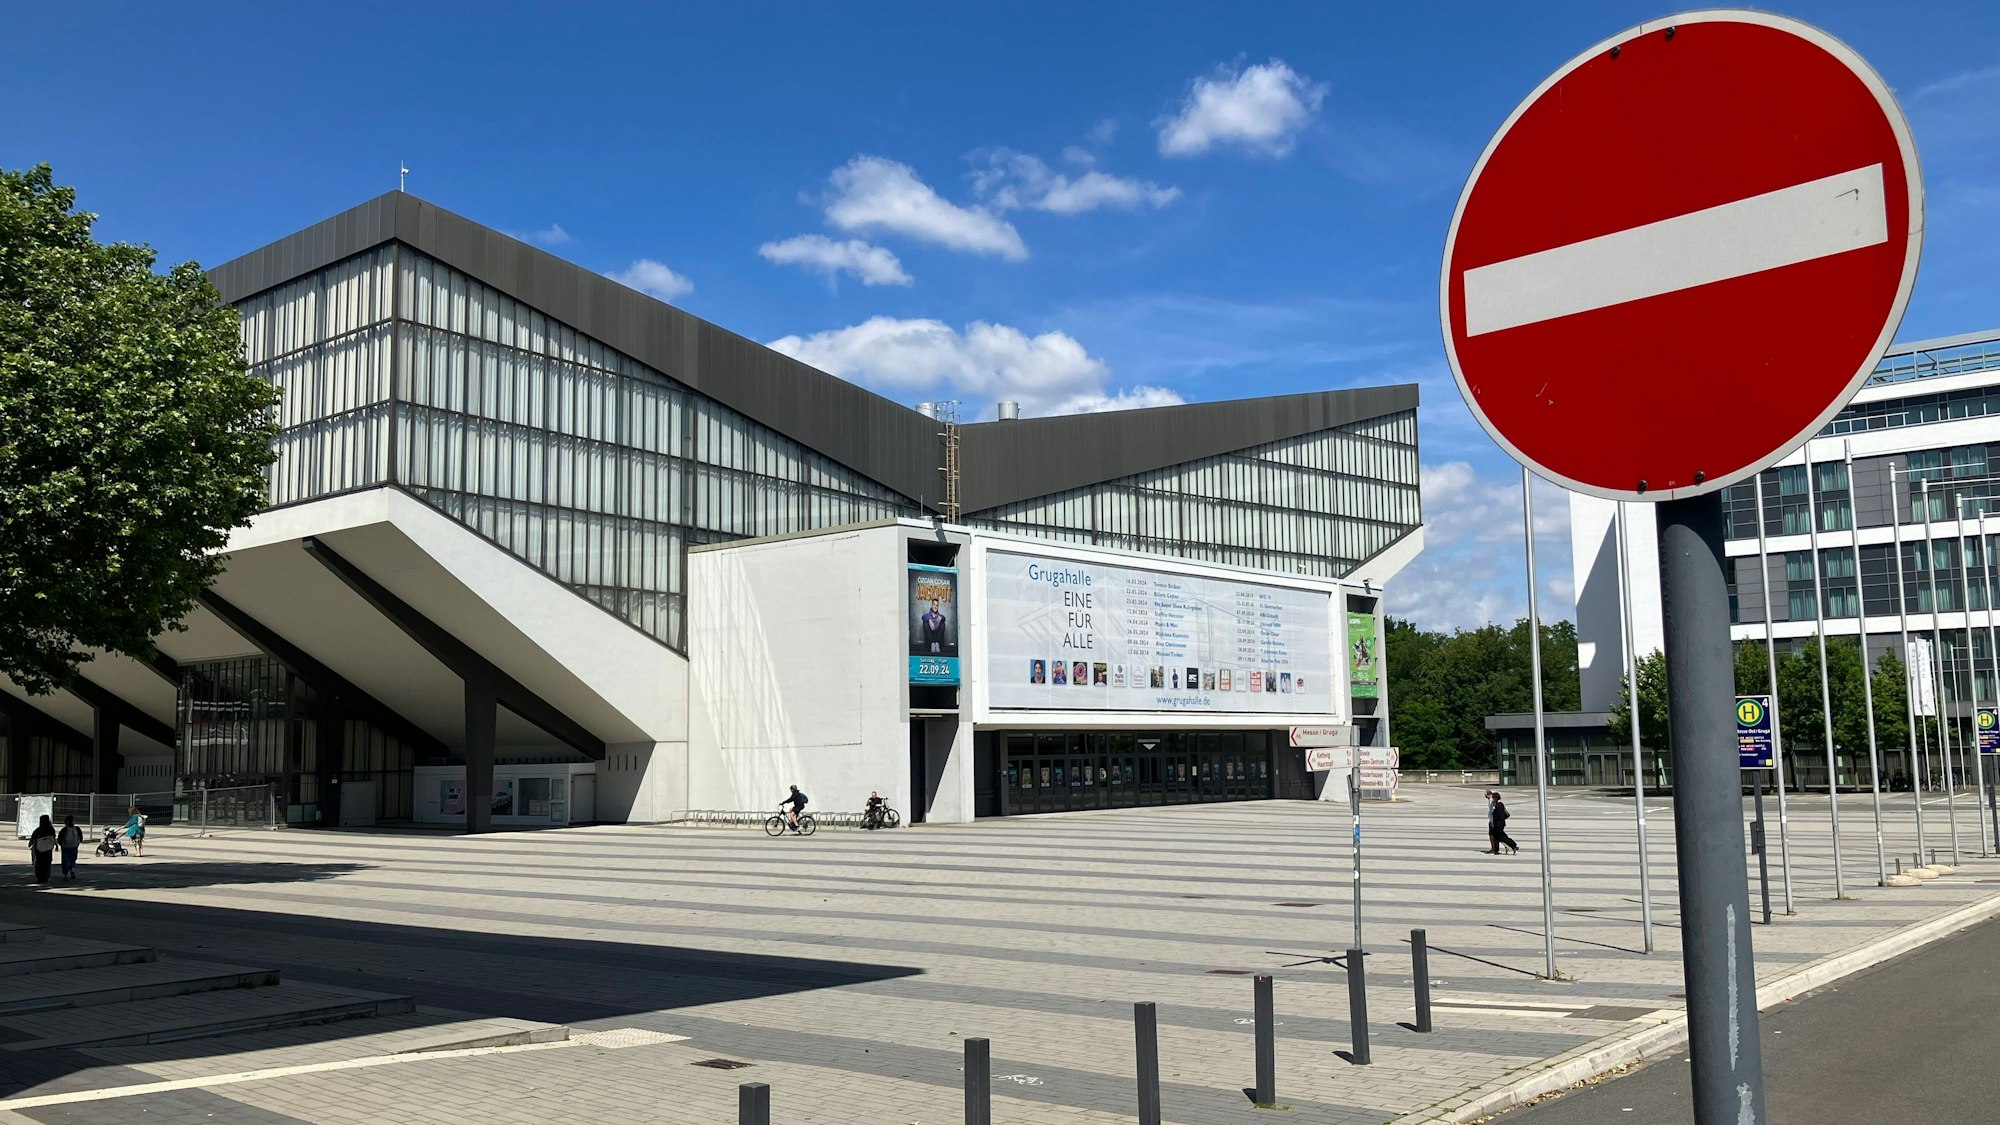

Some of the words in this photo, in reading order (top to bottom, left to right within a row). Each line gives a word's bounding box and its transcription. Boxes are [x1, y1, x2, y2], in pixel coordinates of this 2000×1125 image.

[1028, 564, 1092, 588] Grugahalle
[916, 584, 952, 602] JACKPOT
[1064, 591, 1092, 609] EINE
[1068, 610, 1093, 629] FÜR
[1063, 632, 1093, 649] ALLE
[920, 665, 950, 675] 22.09.24
[1156, 696, 1210, 707] www.grugahalle.de
[1762, 698, 1768, 708] 4
[1743, 705, 1755, 720] H
[1981, 715, 1989, 724] H
